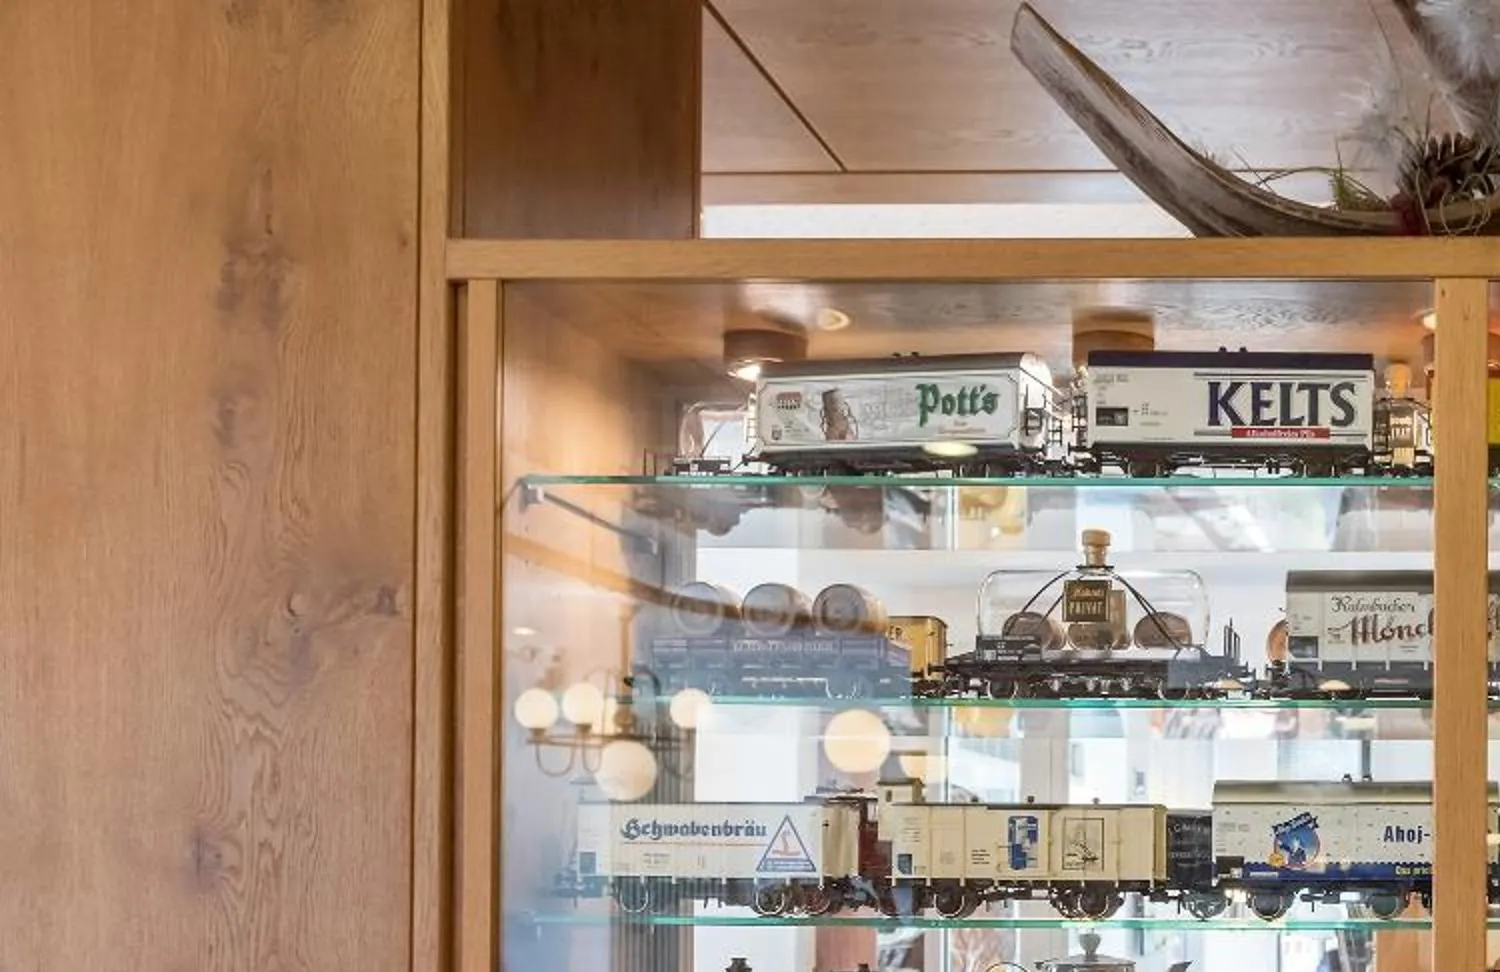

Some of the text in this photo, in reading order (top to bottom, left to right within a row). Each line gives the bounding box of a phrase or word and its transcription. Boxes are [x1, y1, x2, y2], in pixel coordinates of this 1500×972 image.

[915, 383, 1000, 428] Pott's
[1207, 381, 1356, 427] KELTS
[621, 817, 768, 840] Schwabenbräu
[1384, 825, 1431, 844] Ahoj-
